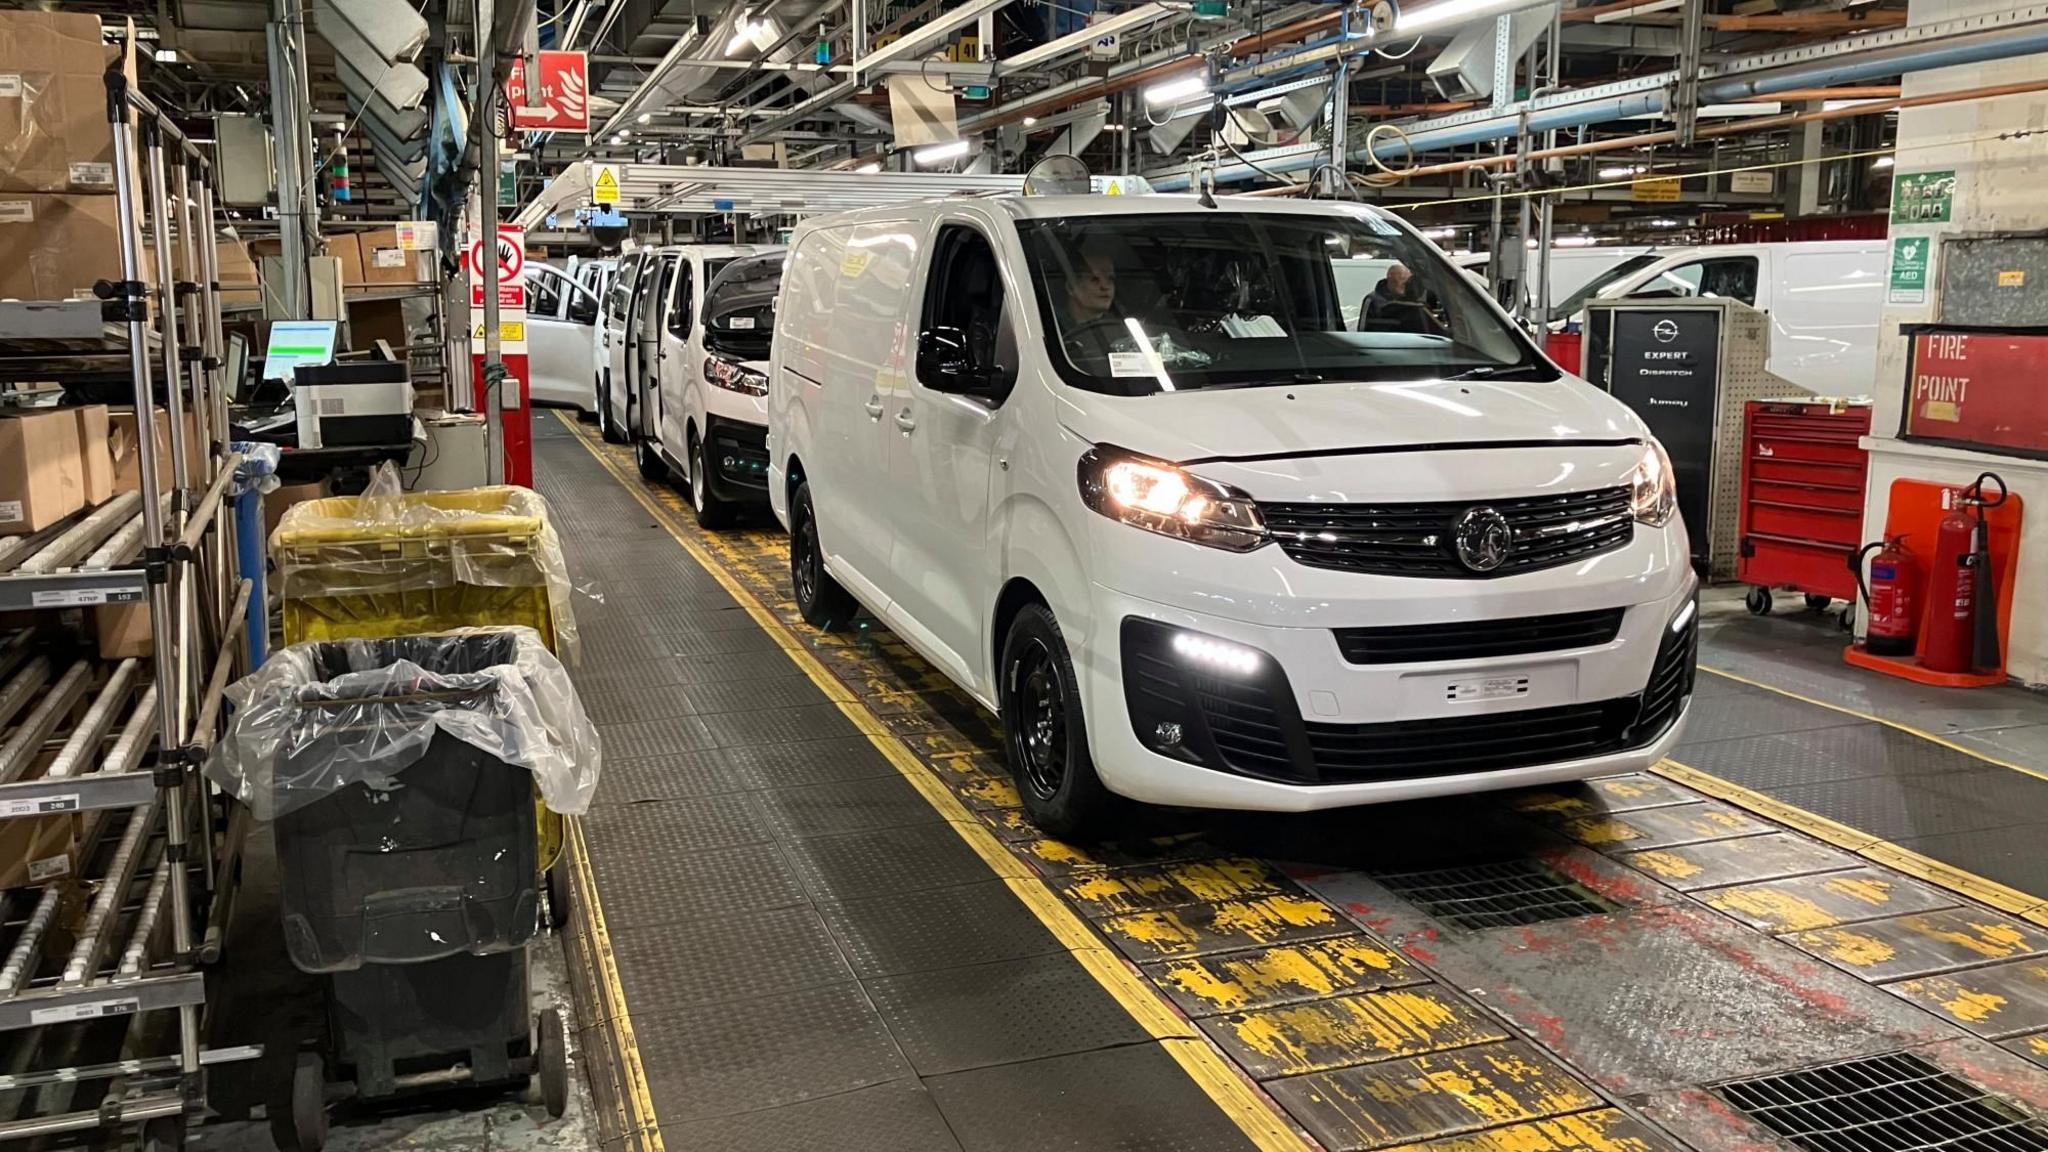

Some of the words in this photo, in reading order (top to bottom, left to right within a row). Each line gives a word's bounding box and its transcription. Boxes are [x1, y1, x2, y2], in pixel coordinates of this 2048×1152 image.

[1899, 271, 1918, 280] AED
[1644, 351, 1688, 360] EXPERT
[1927, 335, 1968, 360] FIRE
[1917, 375, 1970, 402] POINT
